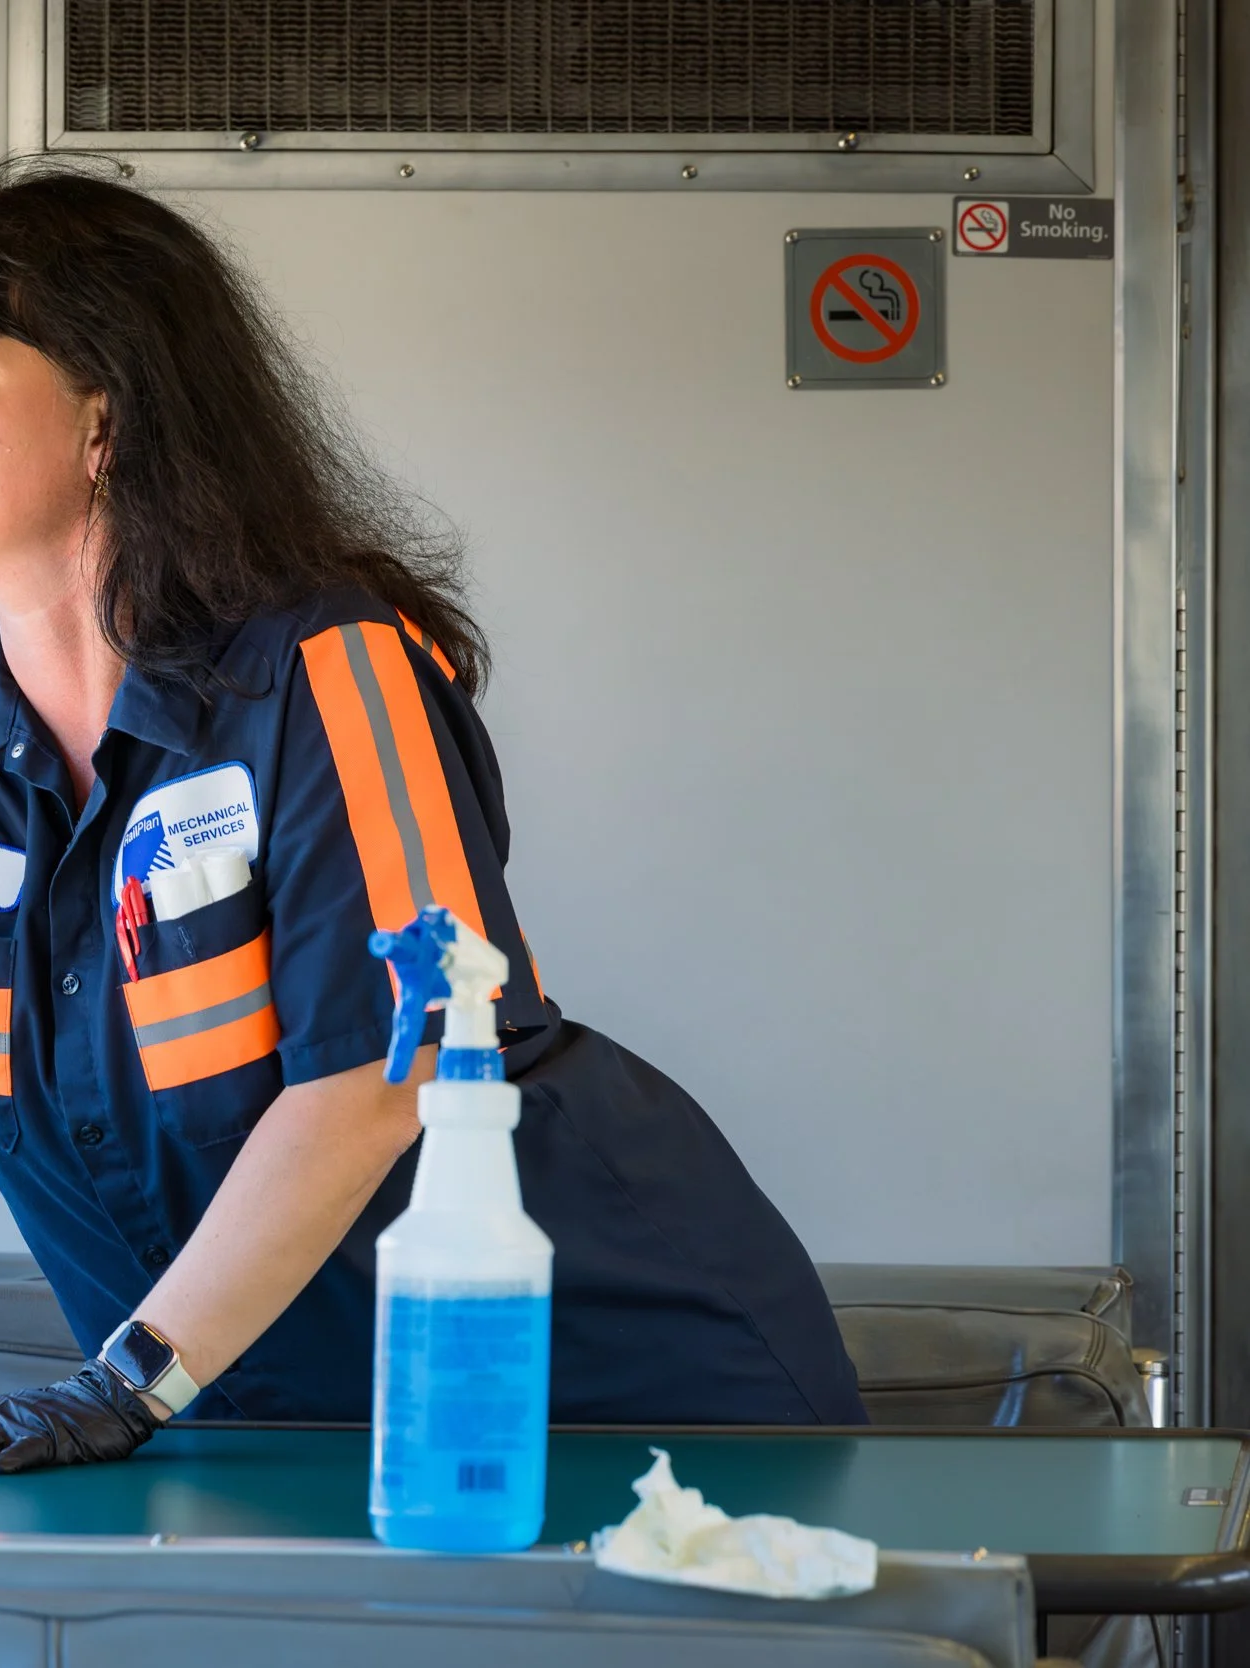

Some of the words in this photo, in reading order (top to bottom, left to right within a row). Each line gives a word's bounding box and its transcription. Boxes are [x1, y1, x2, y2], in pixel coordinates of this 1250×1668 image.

[1049, 204, 1076, 220] No
[1020, 221, 1109, 243] Smoking.
[167, 801, 250, 836] MECHANICAL
[183, 819, 245, 847] SERVICES
